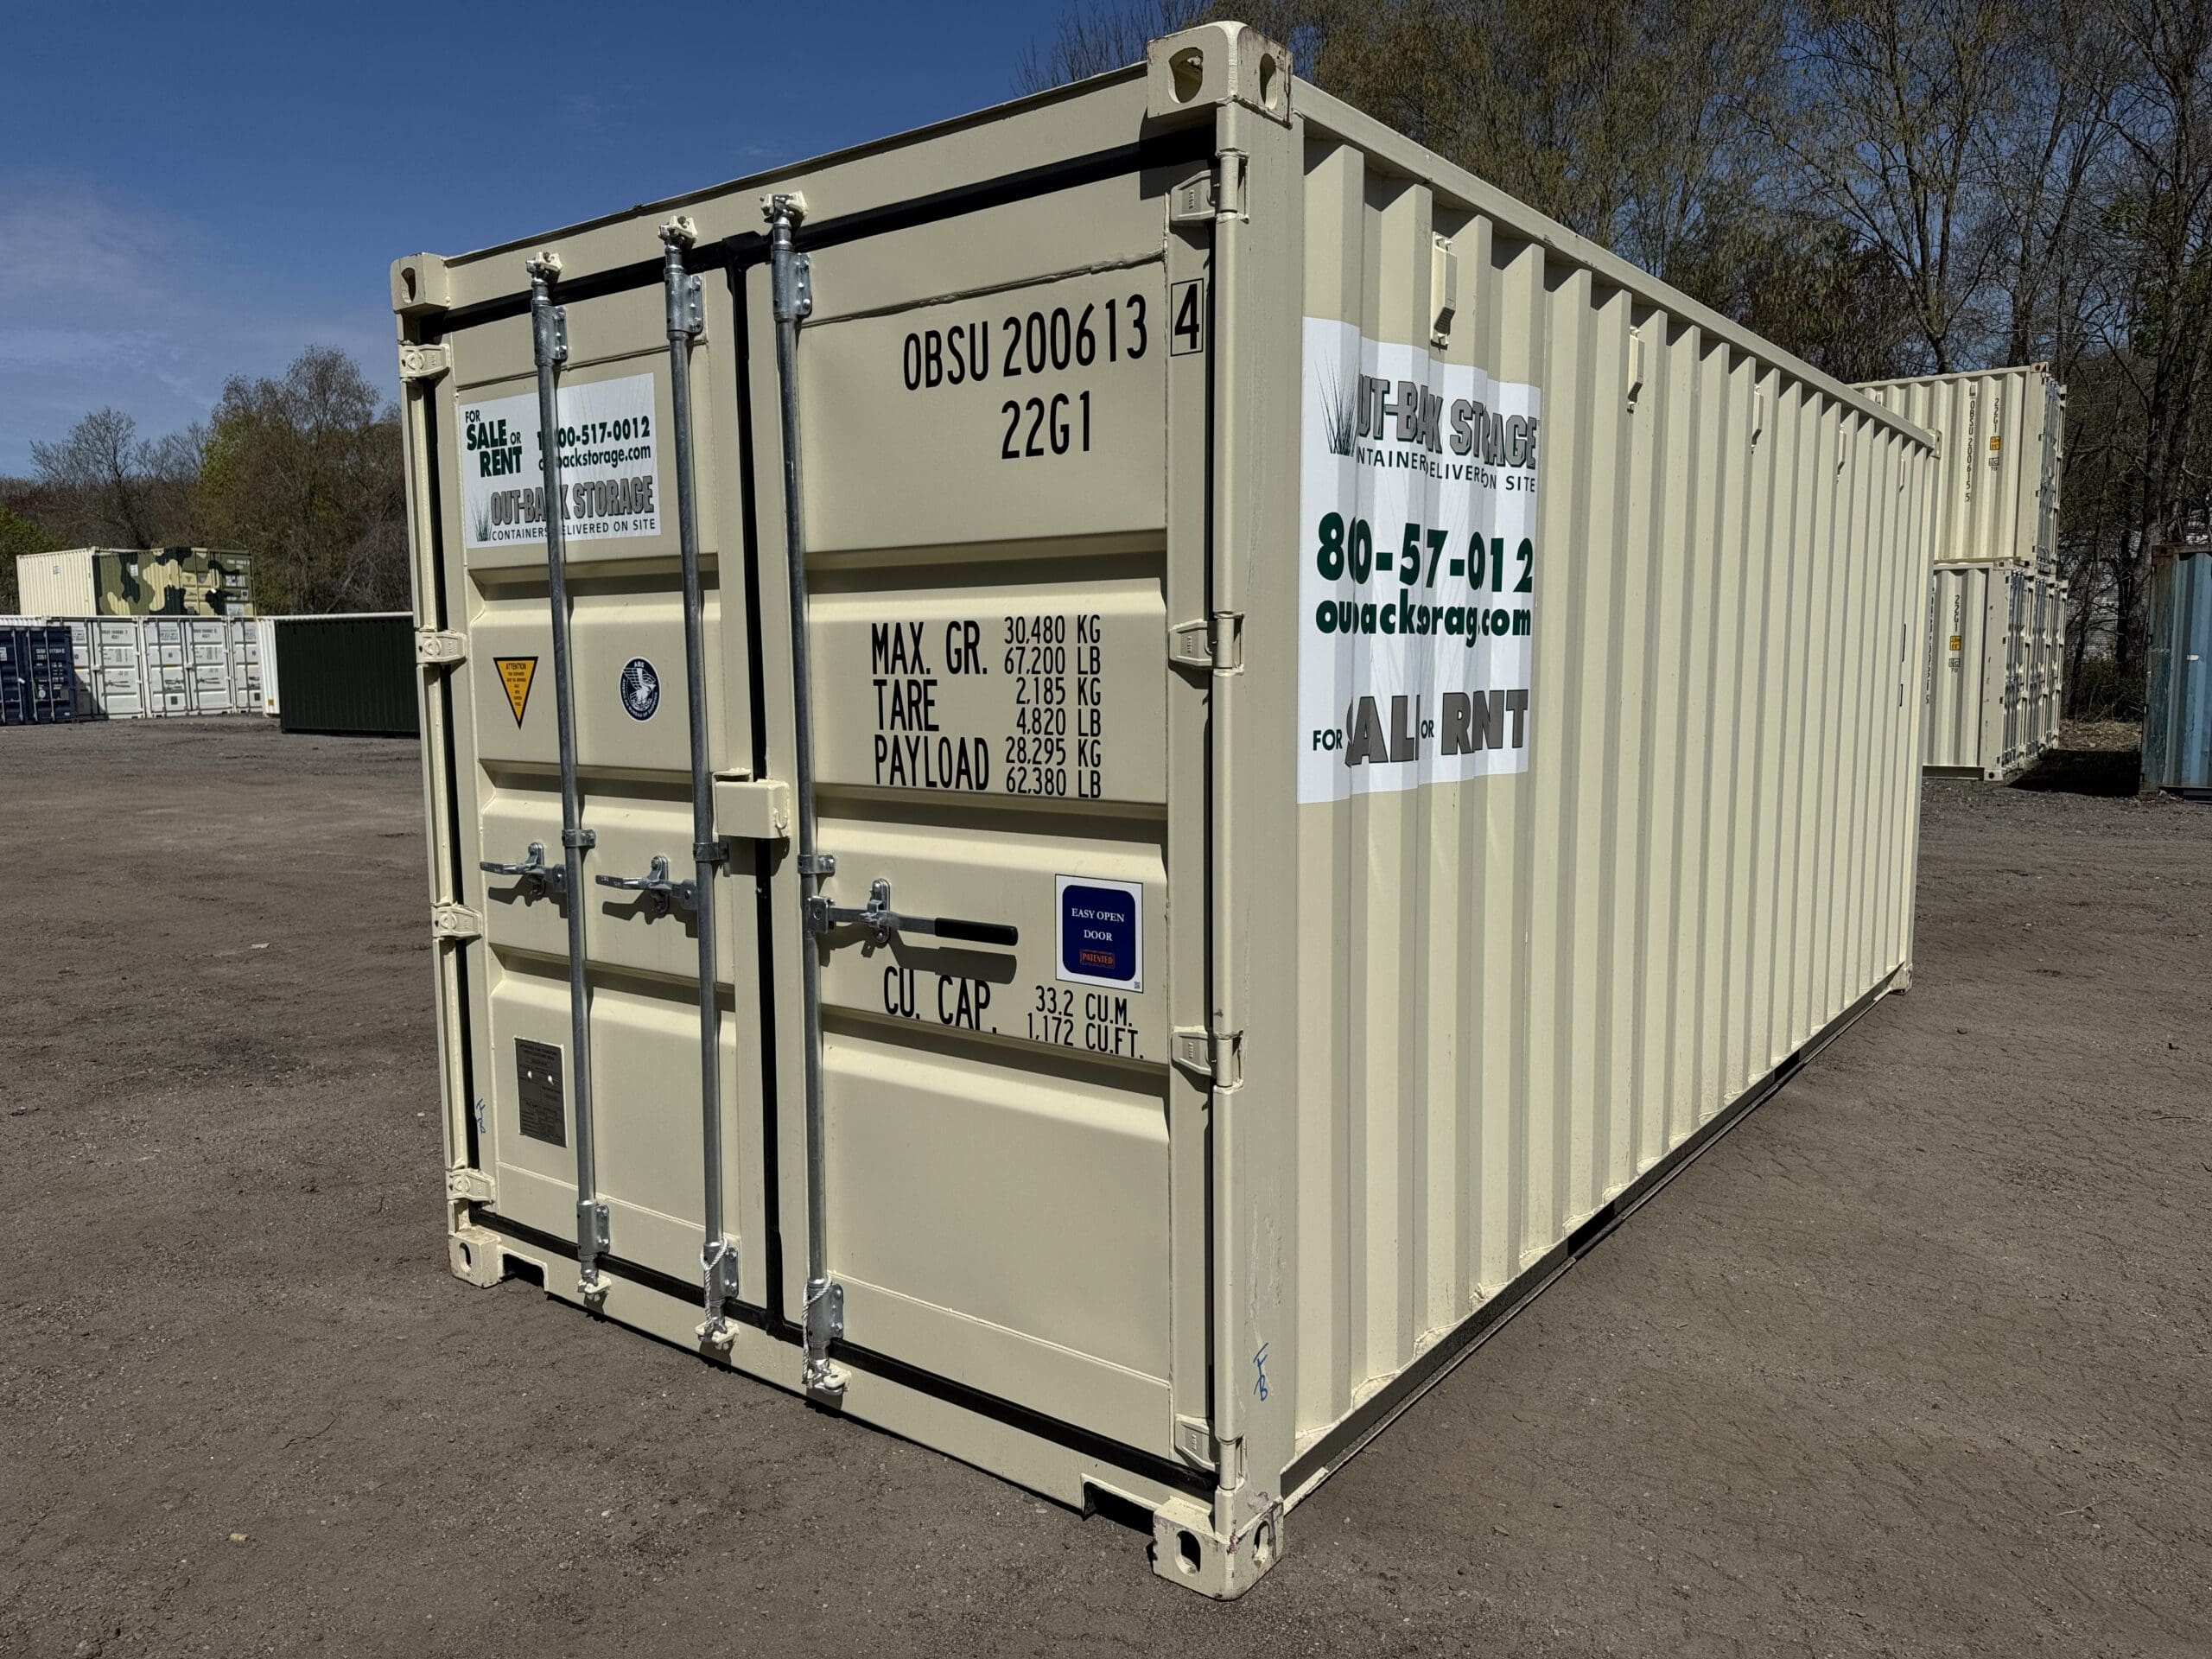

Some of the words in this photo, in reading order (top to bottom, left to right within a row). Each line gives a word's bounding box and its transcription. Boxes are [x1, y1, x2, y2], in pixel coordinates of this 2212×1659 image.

[903, 321, 989, 391] OBSU
[1002, 294, 1147, 378] 200613
[1174, 283, 1199, 350] 4
[465, 410, 480, 423] FOR
[1001, 391, 1090, 460] 22G1
[467, 419, 507, 451] SALE
[510, 432, 522, 446] OR
[537, 416, 651, 451] 100-517-0012
[480, 446, 523, 478] RENT
[538, 445, 652, 471] oackstorage.com
[1505, 475, 1535, 493] SITE
[491, 484, 571, 526] OUT-BAK
[572, 475, 656, 519] STORAGE
[562, 521, 609, 537] ELIVERED
[613, 520, 629, 532] ON
[632, 518, 656, 531] SITE
[872, 621, 931, 675] MAX.
[946, 620, 988, 675] GR.
[1004, 614, 1065, 645] 30,480
[1077, 614, 1101, 644] KG
[1004, 646, 1065, 675] 67,200
[1077, 645, 1101, 675] LB
[873, 678, 939, 732] TARE
[1016, 677, 1065, 705] 2,185
[1077, 677, 1101, 706] KG
[1016, 707, 1066, 736] 4,820
[1077, 708, 1101, 737] LB
[1313, 728, 1343, 752] FOR
[1421, 719, 1434, 740] OR
[1440, 689, 1529, 756] RNT
[874, 734, 989, 791] PAYLOAD
[1006, 736, 1066, 766] 28,295
[1077, 738, 1102, 767] KG
[1007, 766, 1066, 796] 62,380
[1078, 769, 1102, 798] LB
[1071, 907, 1096, 918] EASY
[1096, 911, 1125, 923] OPEN
[1084, 929, 1113, 941] DOOR
[1082, 953, 1113, 964] PATENTED
[884, 965, 920, 1020] CU.
[938, 974, 997, 1034] CAP.
[1035, 985, 1074, 1017] 33.2
[1085, 993, 1132, 1027] CU.M.
[1027, 1012, 1074, 1046] 1,172
[1085, 1022, 1144, 1058] CU.FT.
